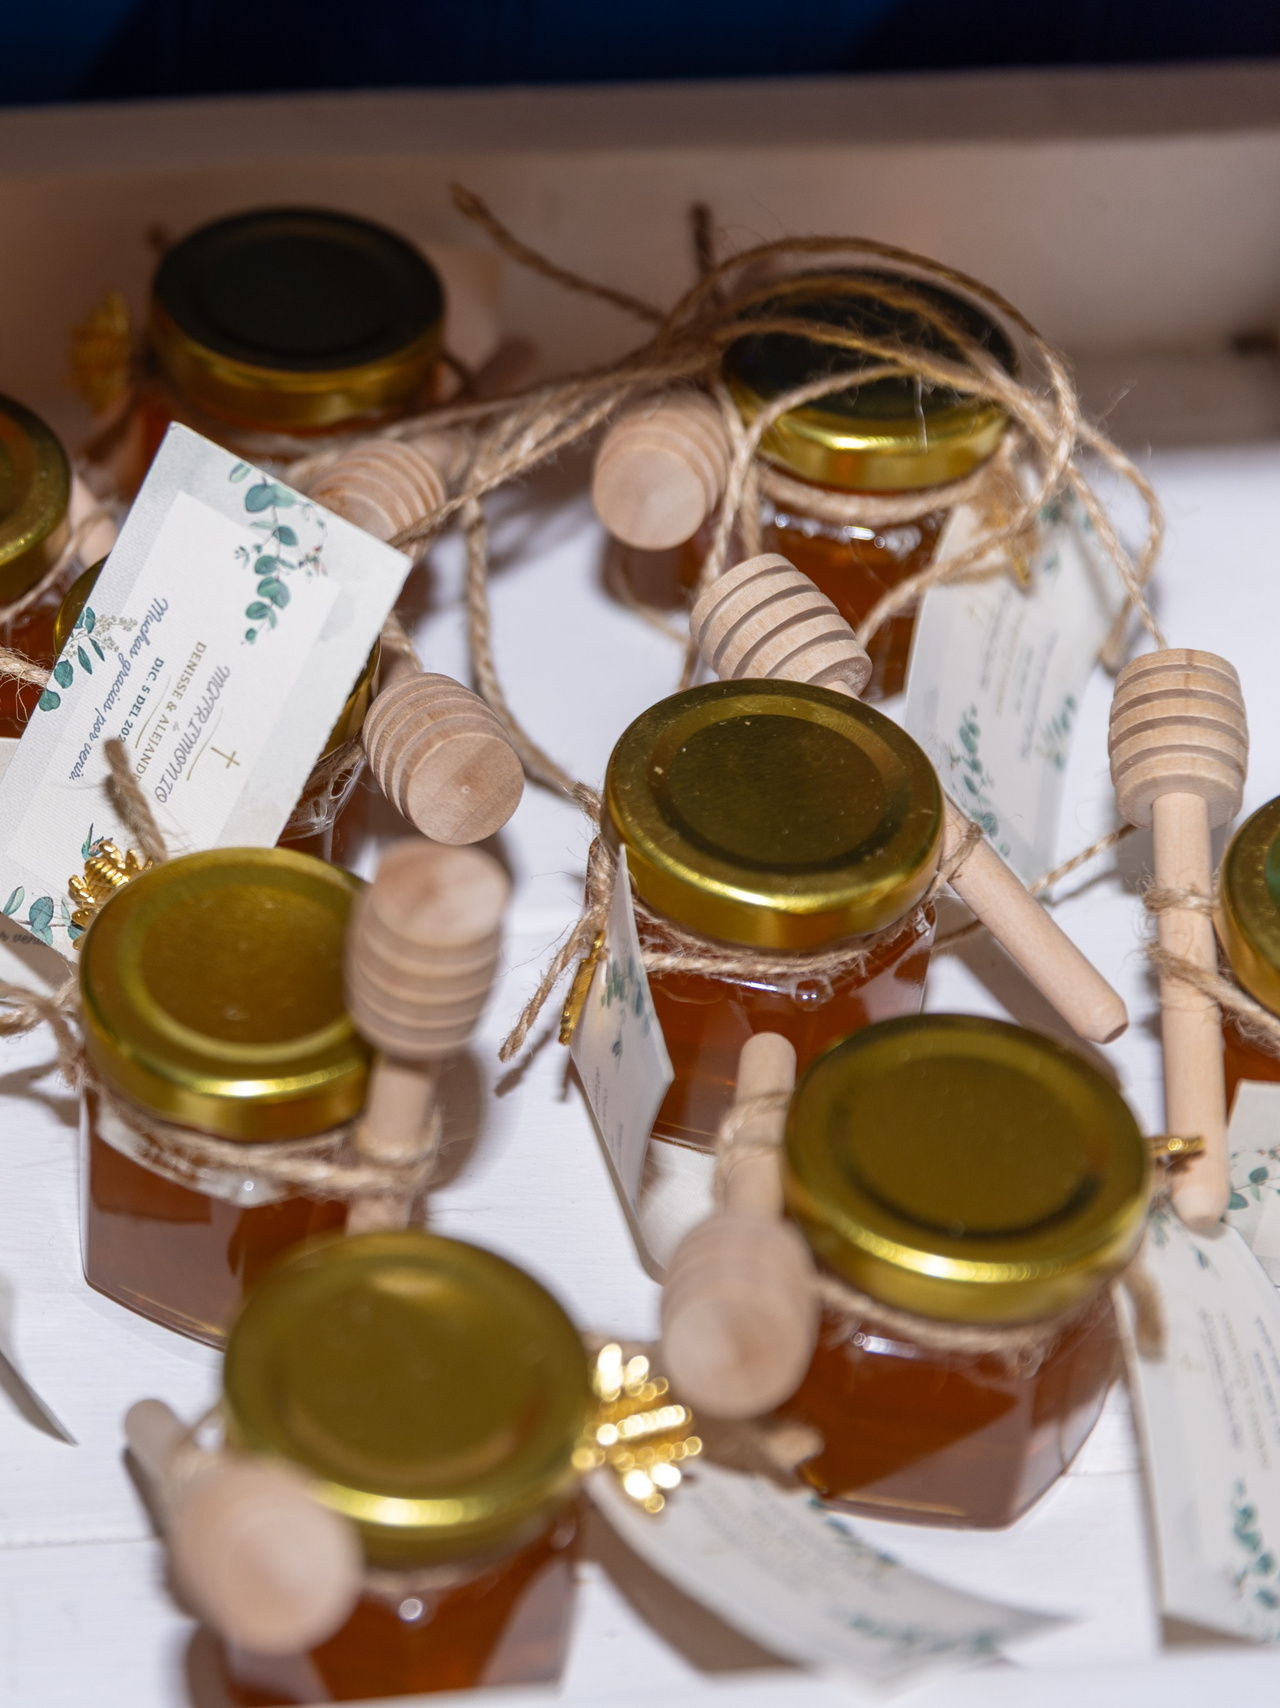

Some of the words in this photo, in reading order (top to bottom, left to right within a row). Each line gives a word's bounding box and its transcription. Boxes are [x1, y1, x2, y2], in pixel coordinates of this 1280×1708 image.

[130, 598, 168, 658] Muchas
[103, 652, 131, 712] gracias
[146, 657, 164, 683] DIC.
[176, 641, 207, 699] DENISSE
[128, 694, 145, 719] DEL
[140, 684, 150, 694] 5
[165, 700, 177, 712] &
[88, 707, 106, 741] por
[119, 719, 133, 743] 202
[154, 665, 230, 803] MATRIMONIO
[68, 742, 92, 780] venir.
[134, 714, 169, 782] ALEJANDR
